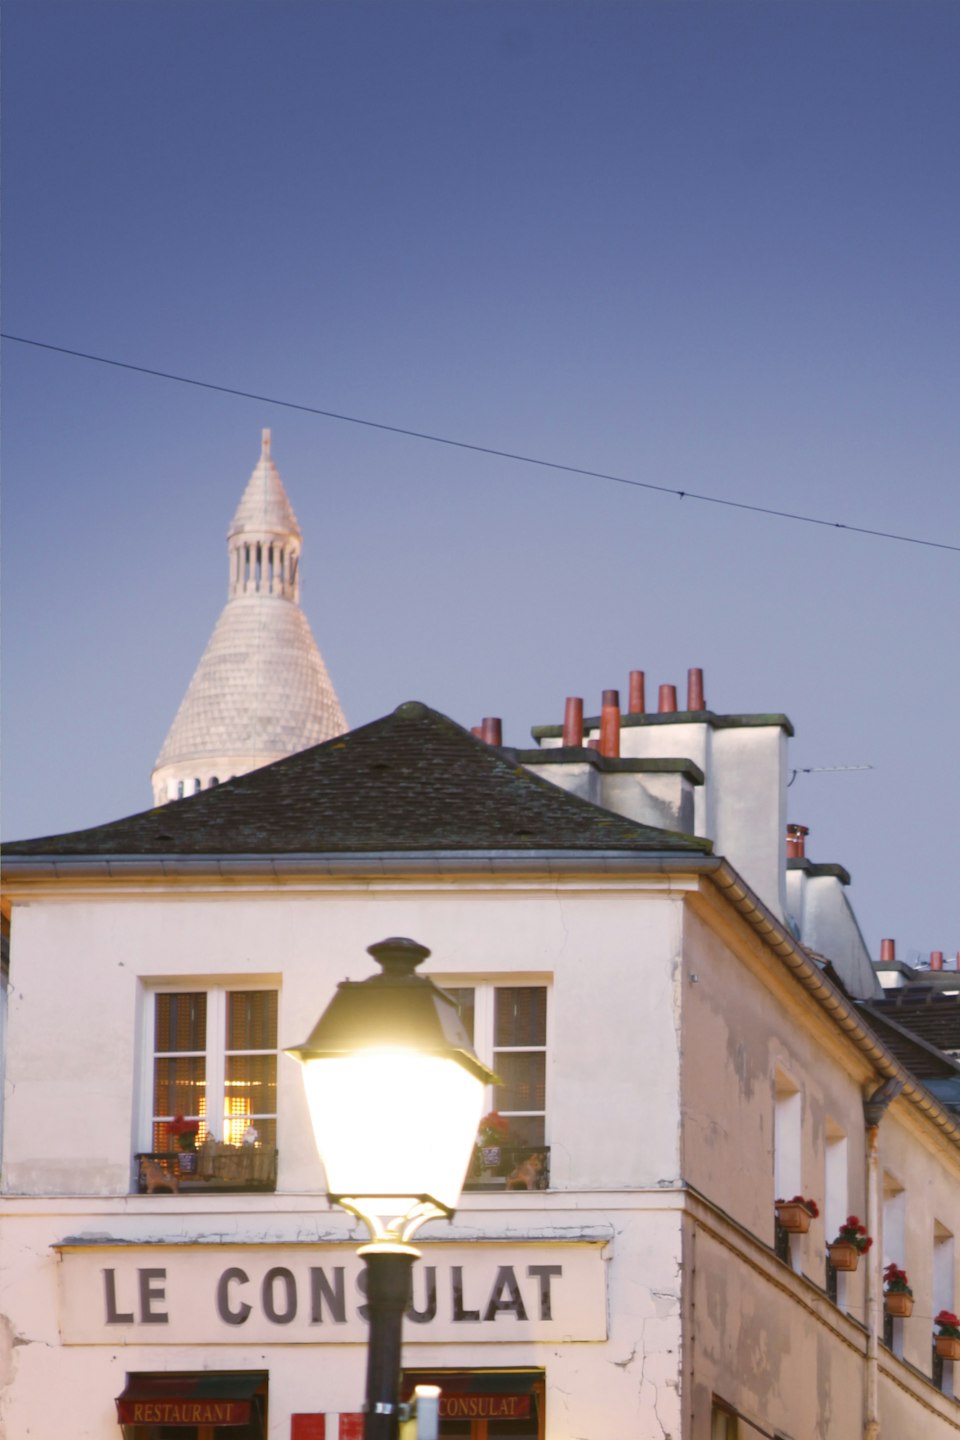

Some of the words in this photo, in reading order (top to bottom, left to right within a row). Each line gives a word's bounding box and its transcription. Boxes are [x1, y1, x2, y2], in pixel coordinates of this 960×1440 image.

[104, 1267, 169, 1325] LE
[133, 1403, 234, 1423] RESTAURANT
[438, 1397, 518, 1418] CONSULAT
